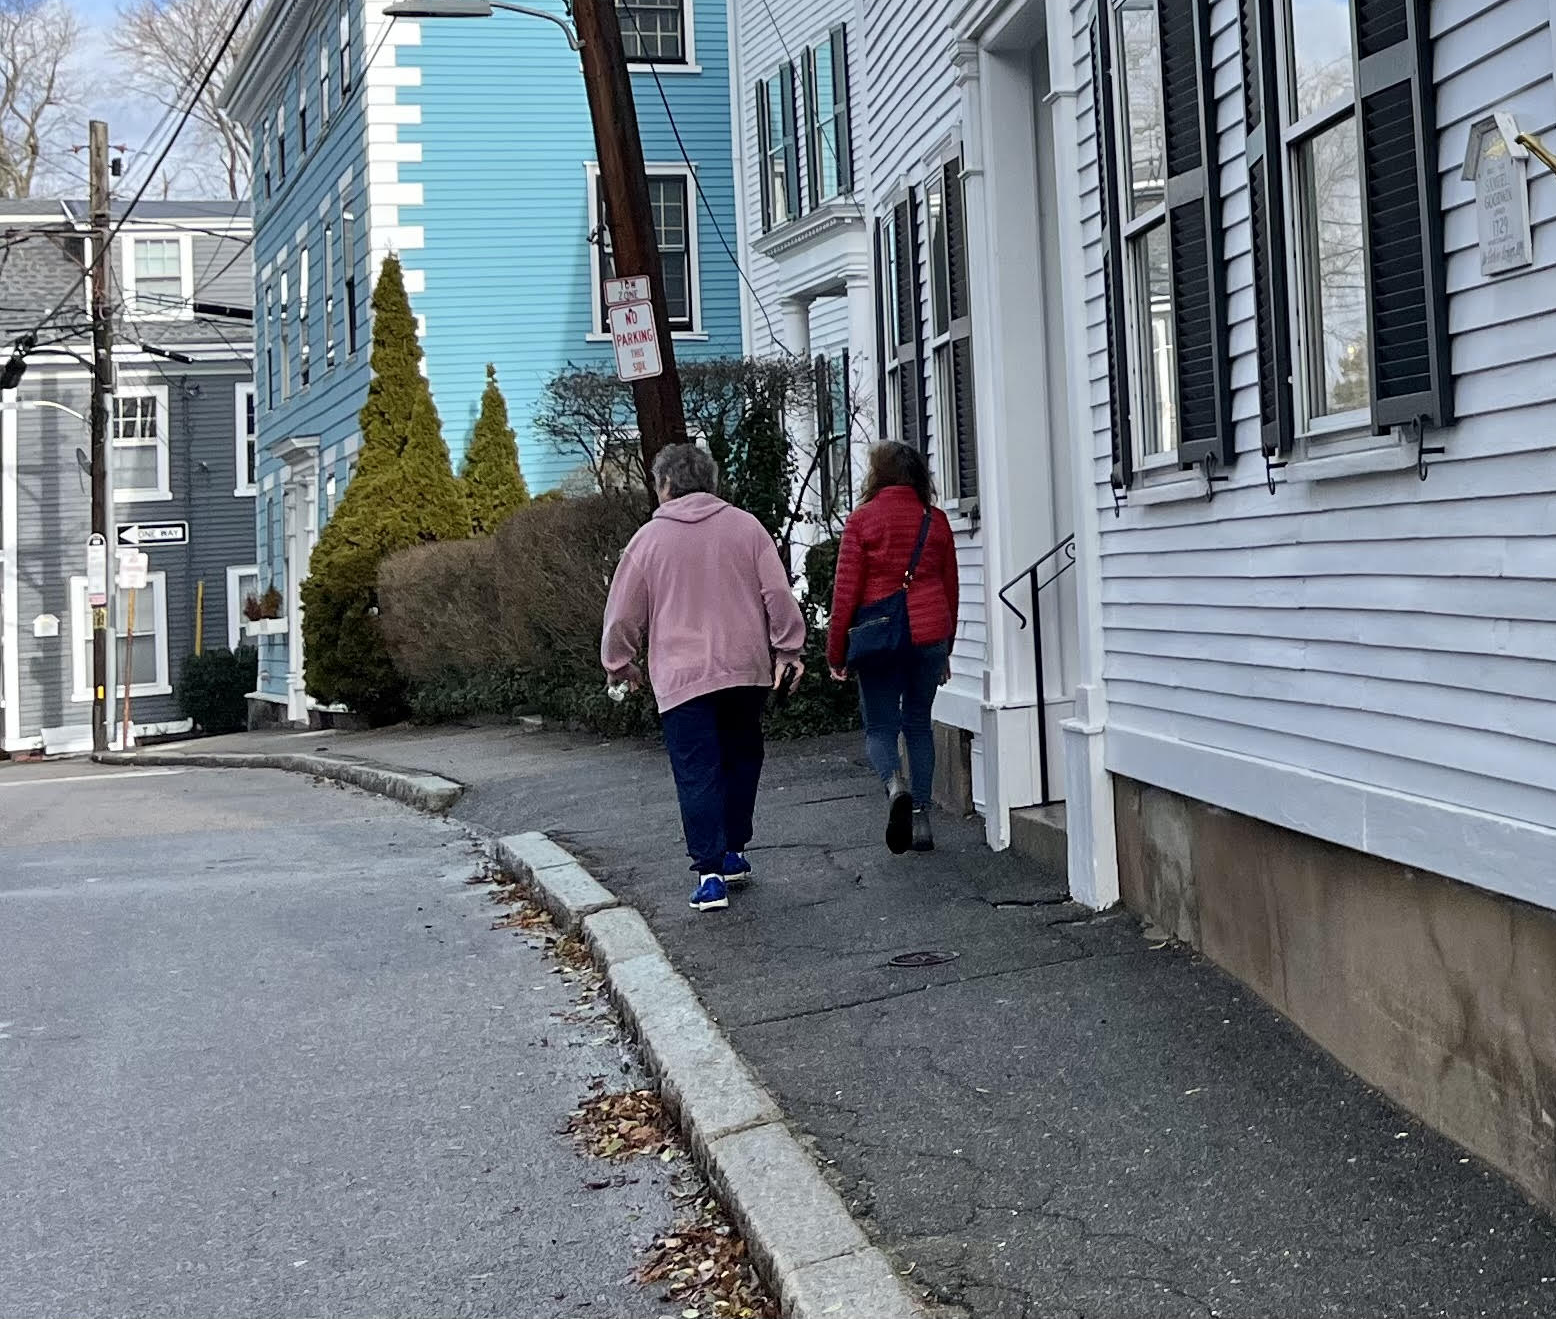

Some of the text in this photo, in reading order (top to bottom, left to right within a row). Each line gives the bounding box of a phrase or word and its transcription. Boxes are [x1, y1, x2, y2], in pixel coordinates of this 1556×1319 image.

[618, 289, 638, 301] ZONE
[624, 310, 638, 325] NO
[616, 328, 654, 347] PARKING
[631, 347, 645, 358] THIS
[138, 529, 179, 539] ONE WAY
